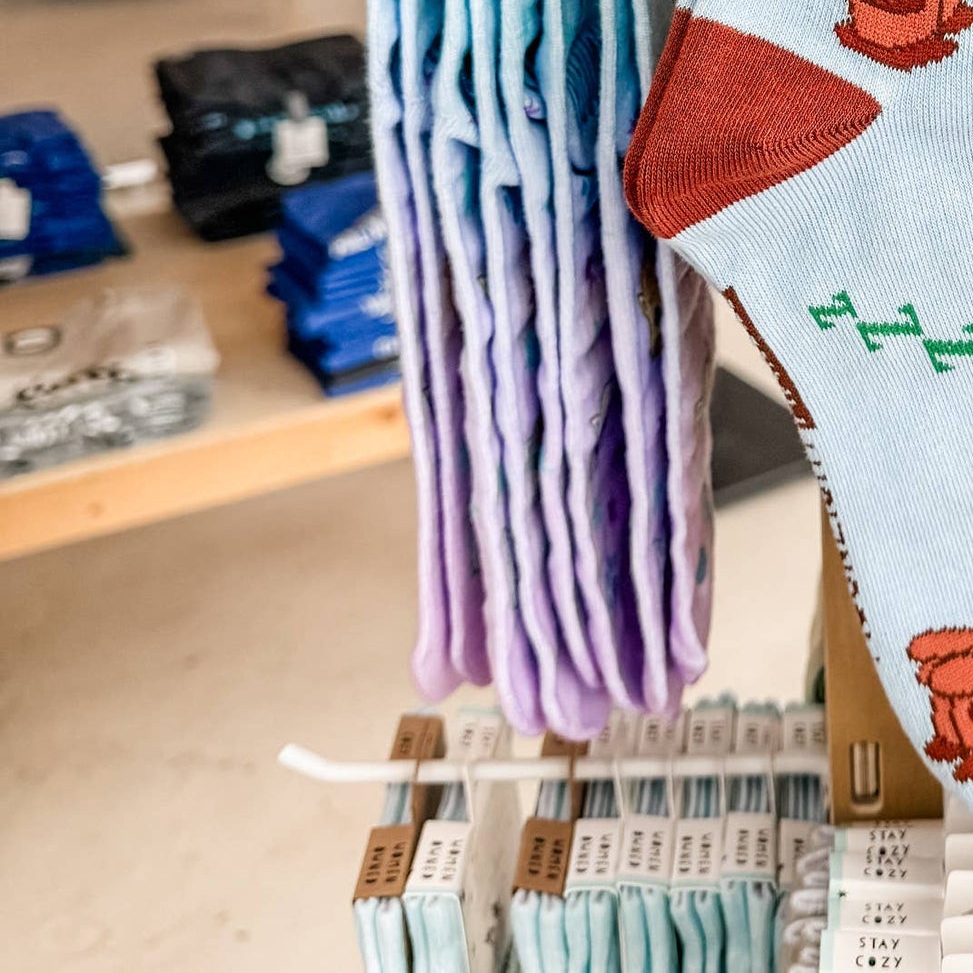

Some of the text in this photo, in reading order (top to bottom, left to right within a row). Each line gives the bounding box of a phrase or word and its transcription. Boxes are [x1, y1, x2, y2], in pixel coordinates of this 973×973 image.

[870, 829, 907, 840] STAY
[864, 868, 907, 878] COZY
[865, 902, 904, 912] STAY
[862, 914, 907, 925] COZY
[859, 937, 900, 950] STAY
[855, 954, 903, 968] COZY
